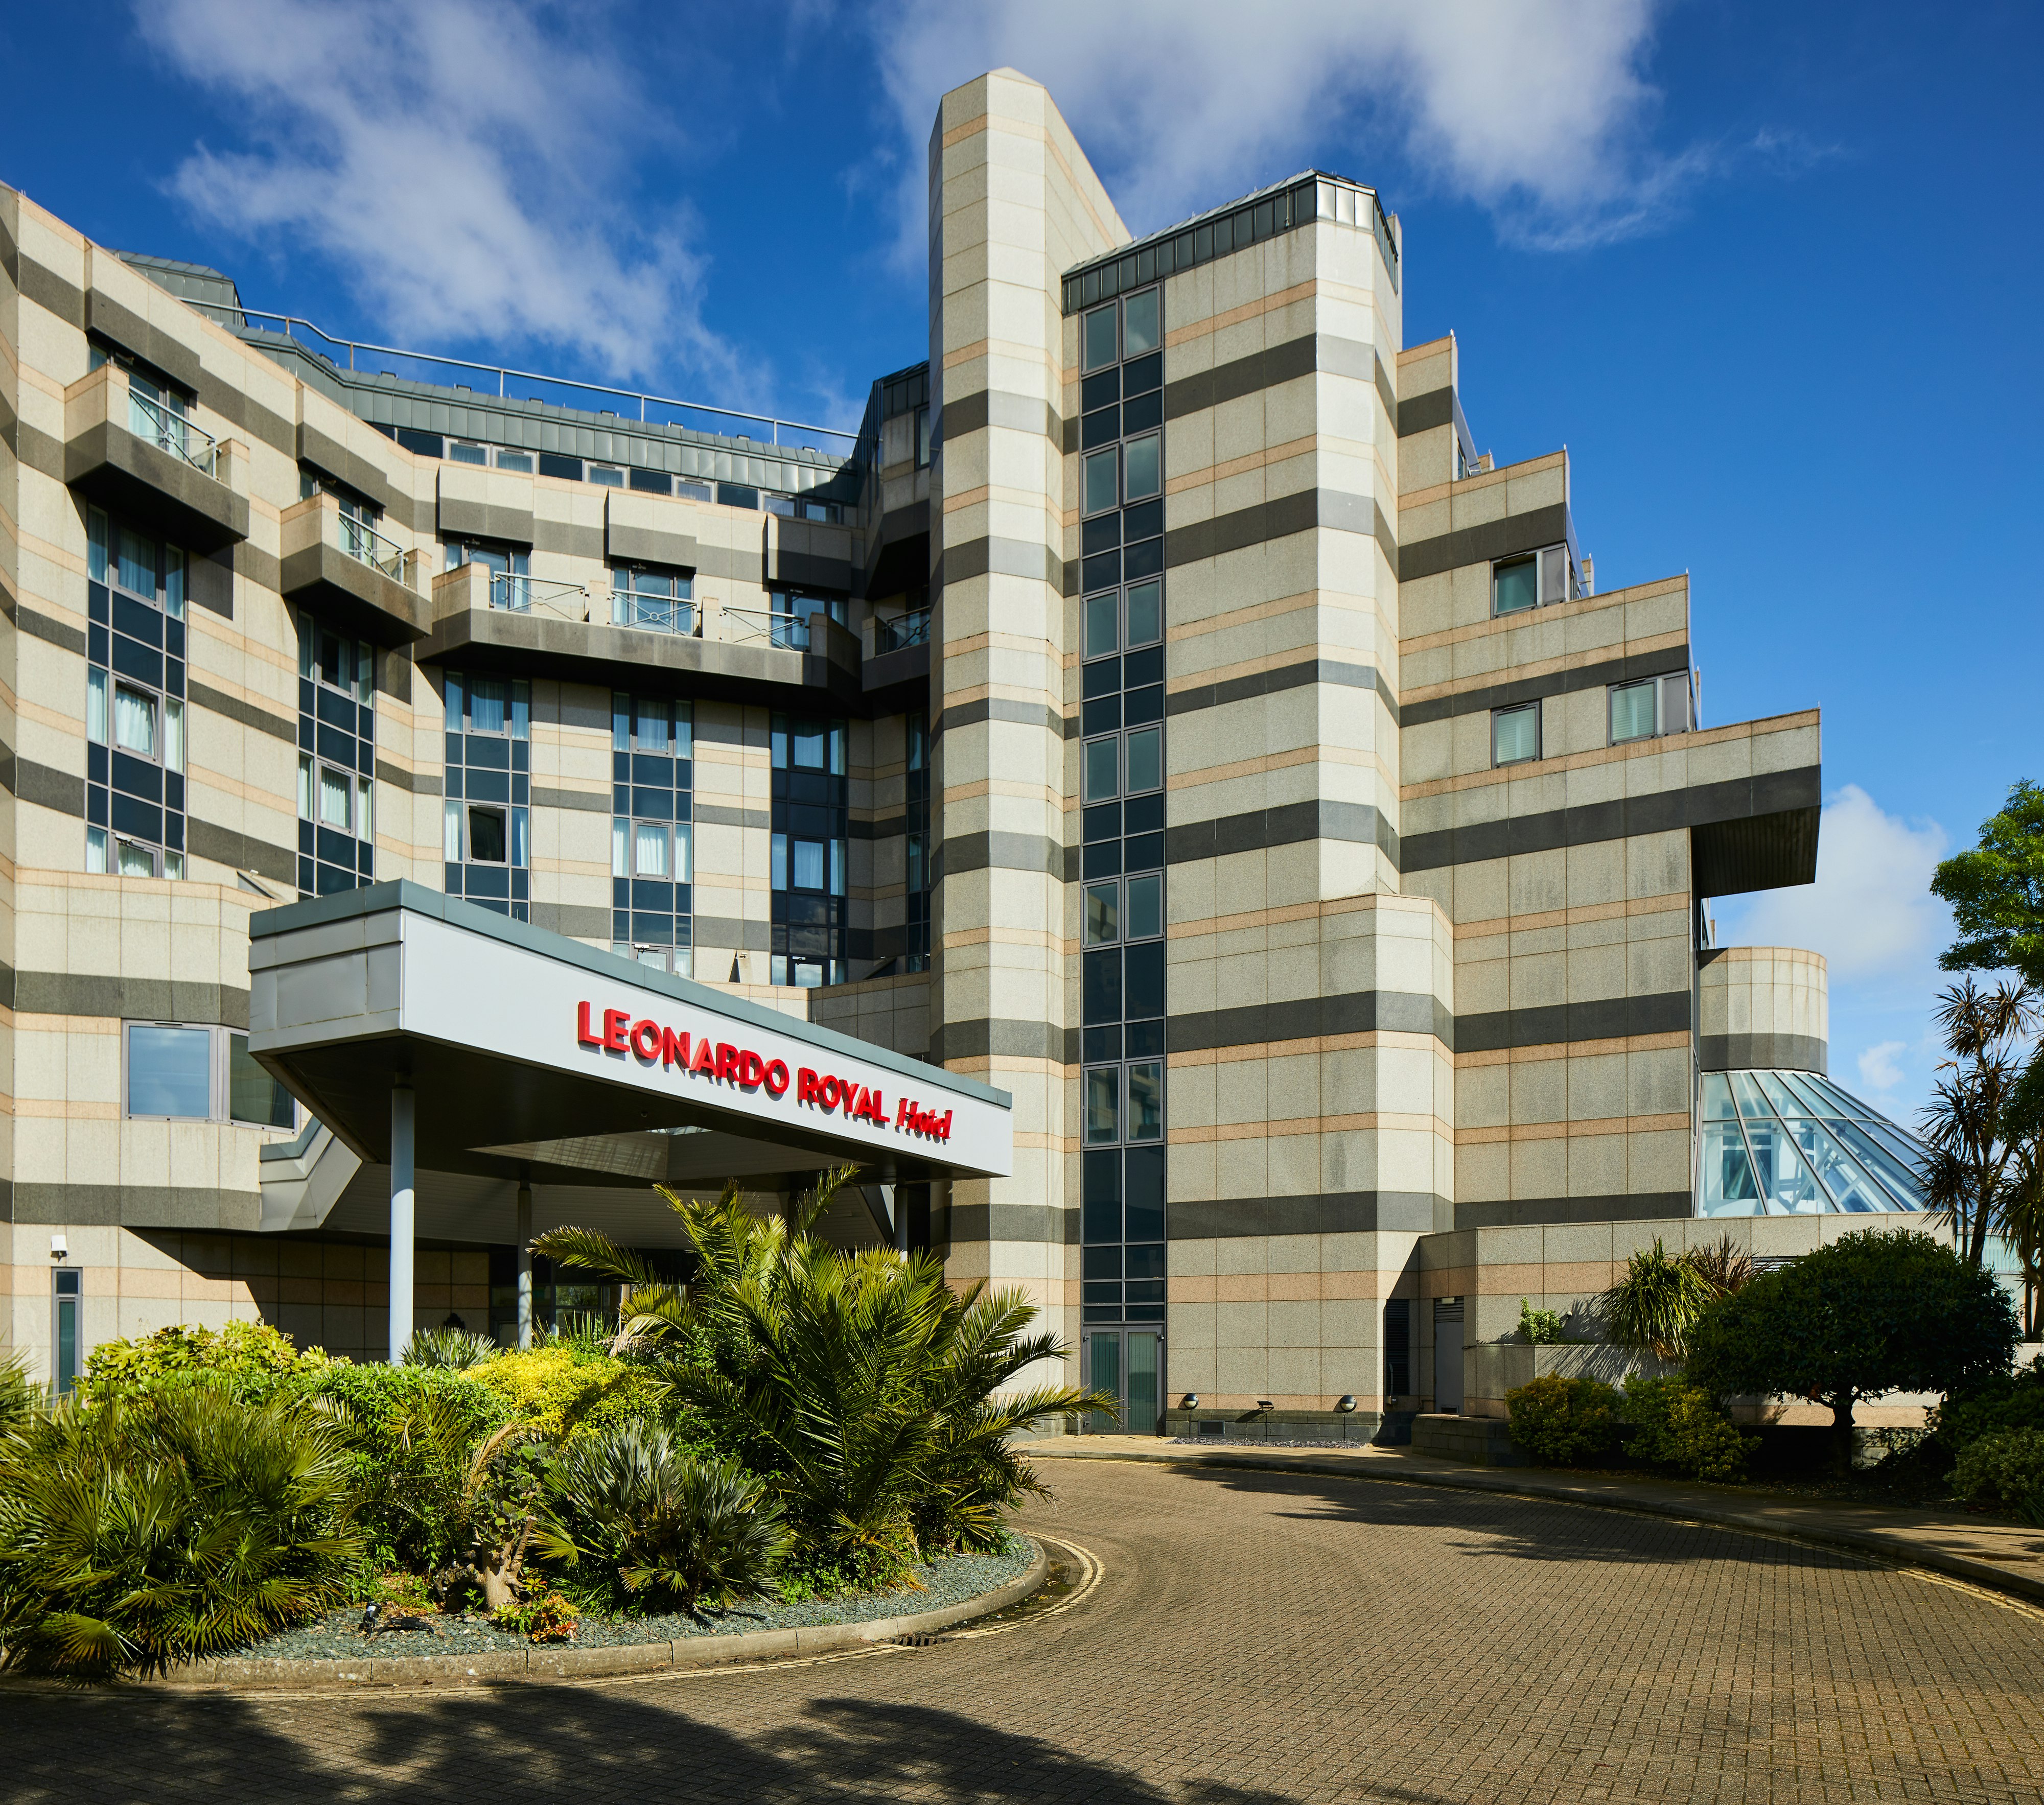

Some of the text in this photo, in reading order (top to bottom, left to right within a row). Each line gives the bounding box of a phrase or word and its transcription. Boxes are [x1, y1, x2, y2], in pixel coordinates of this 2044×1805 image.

[578, 1001, 953, 1139] LEONARDO ROYAL Hotel
